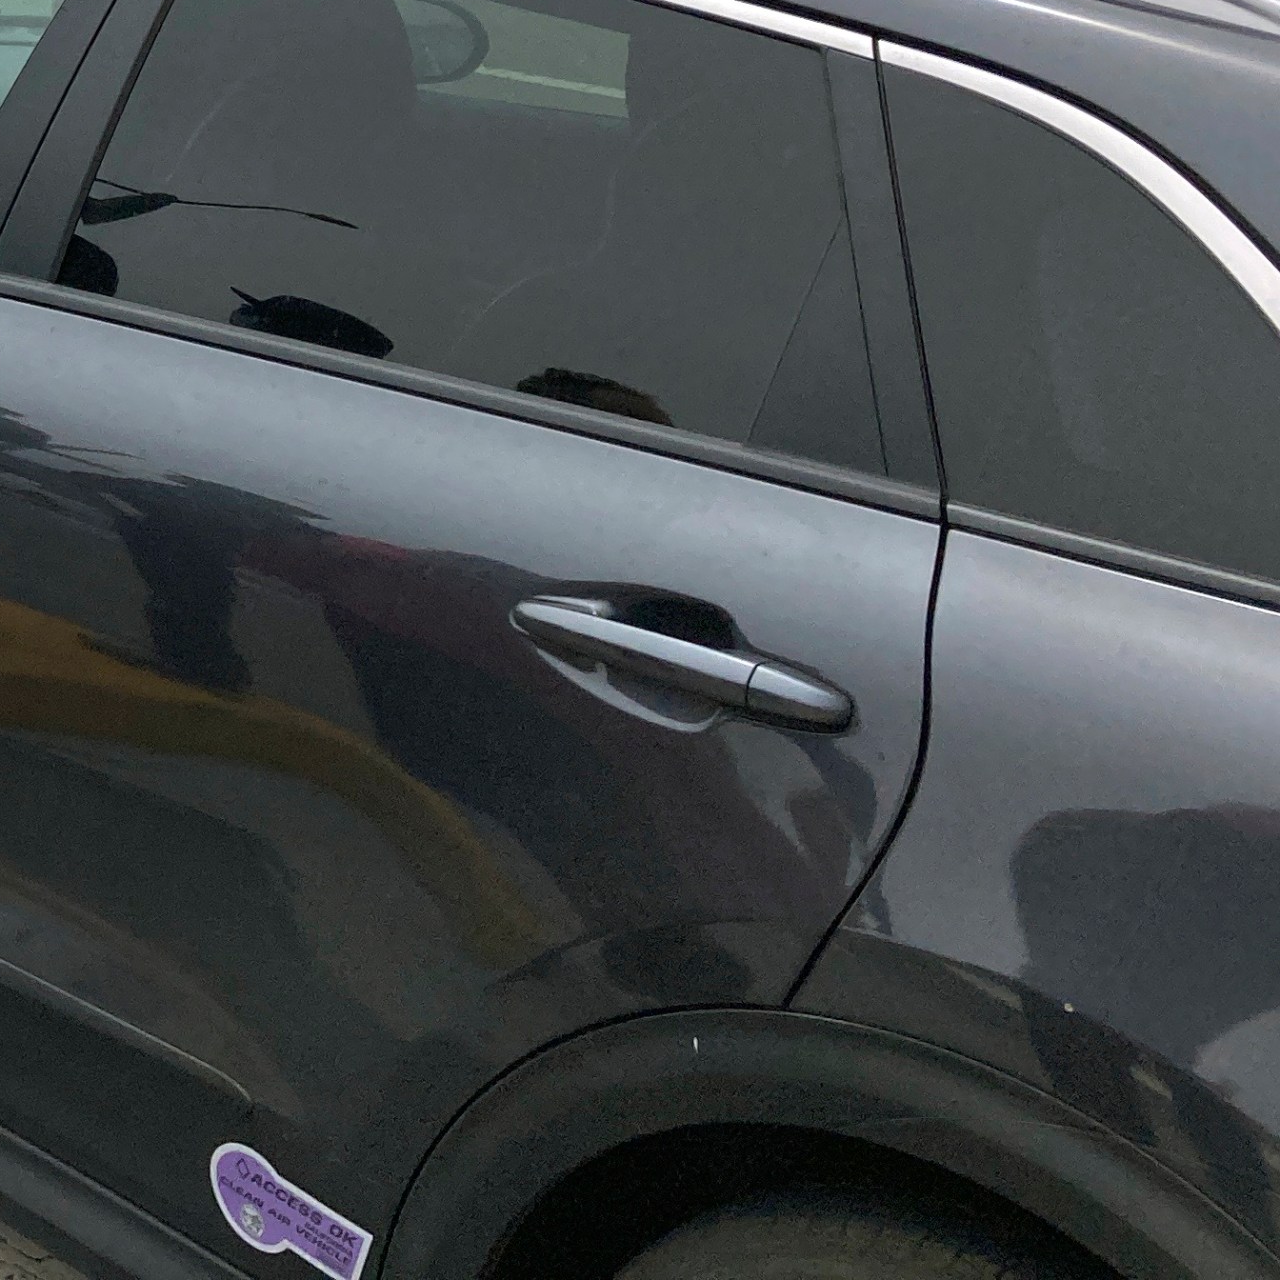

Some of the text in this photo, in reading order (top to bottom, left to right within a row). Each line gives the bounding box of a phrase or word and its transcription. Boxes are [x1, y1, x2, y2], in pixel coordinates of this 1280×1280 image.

[219, 1175, 265, 1208] CLEAN
[267, 1208, 291, 1226] AIR
[296, 1224, 350, 1265] VEHICLE
[250, 1173, 358, 1248] ACCESS OK
